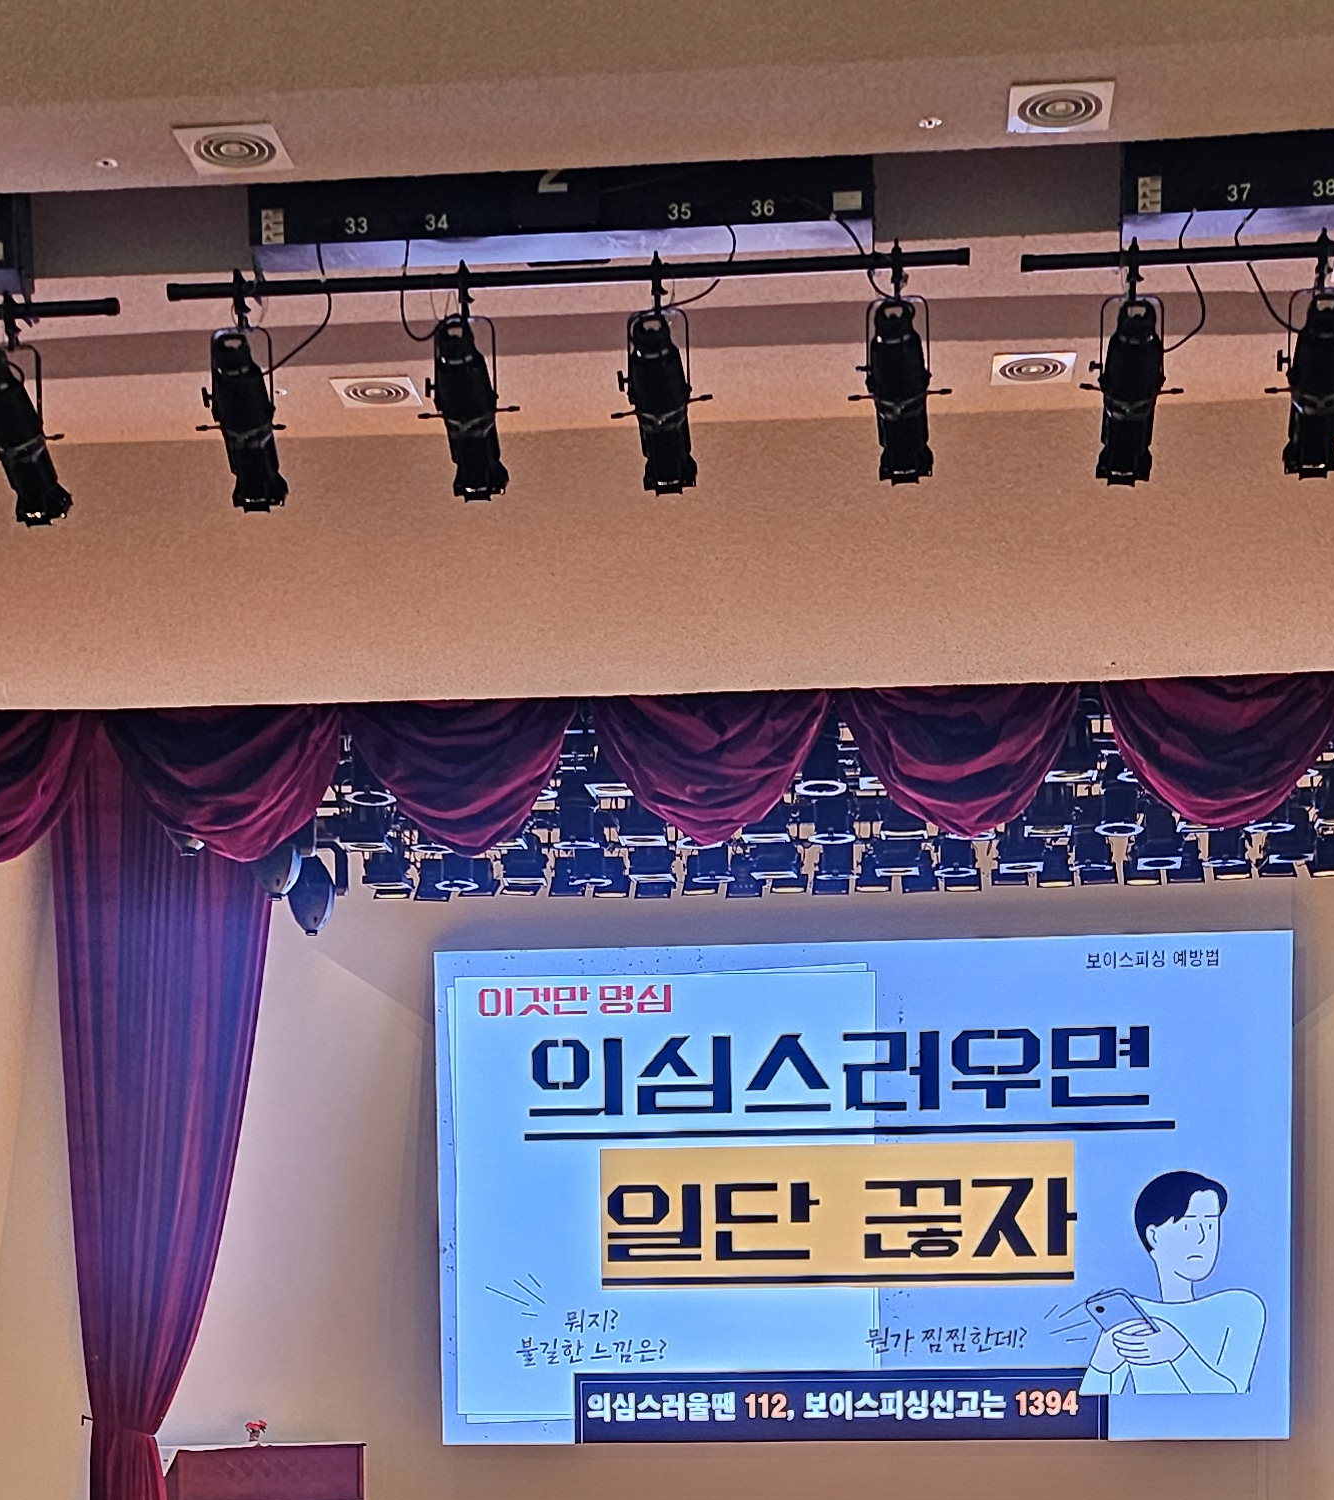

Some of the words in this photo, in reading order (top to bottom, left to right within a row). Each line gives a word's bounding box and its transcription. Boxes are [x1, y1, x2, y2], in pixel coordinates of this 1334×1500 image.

[1226, 184, 1251, 202] 37
[344, 217, 368, 234] 33
[424, 214, 449, 230] 34
[667, 203, 692, 221] 35
[750, 200, 775, 217] 36
[1085, 950, 1167, 971] 보이스피싱
[1172, 948, 1221, 969] 예방법
[477, 985, 590, 1018] 이것만
[598, 983, 674, 1015] 명심
[528, 1025, 1152, 1118] 의심스러우면
[606, 1179, 821, 1263] 일단
[864, 1175, 1078, 1260] 끊자
[564, 1309, 620, 1334] 뭐지?
[515, 1337, 584, 1367] 불길한
[590, 1338, 668, 1366] 느낌은?
[864, 1326, 915, 1355] 뭔가
[920, 1324, 1029, 1354] 찜찜한데?
[586, 1392, 737, 1423] 의심스러울땐
[743, 1393, 796, 1422] 112,
[803, 1391, 1007, 1421] 보이스피싱신고는
[1014, 1391, 1079, 1417] 1394
